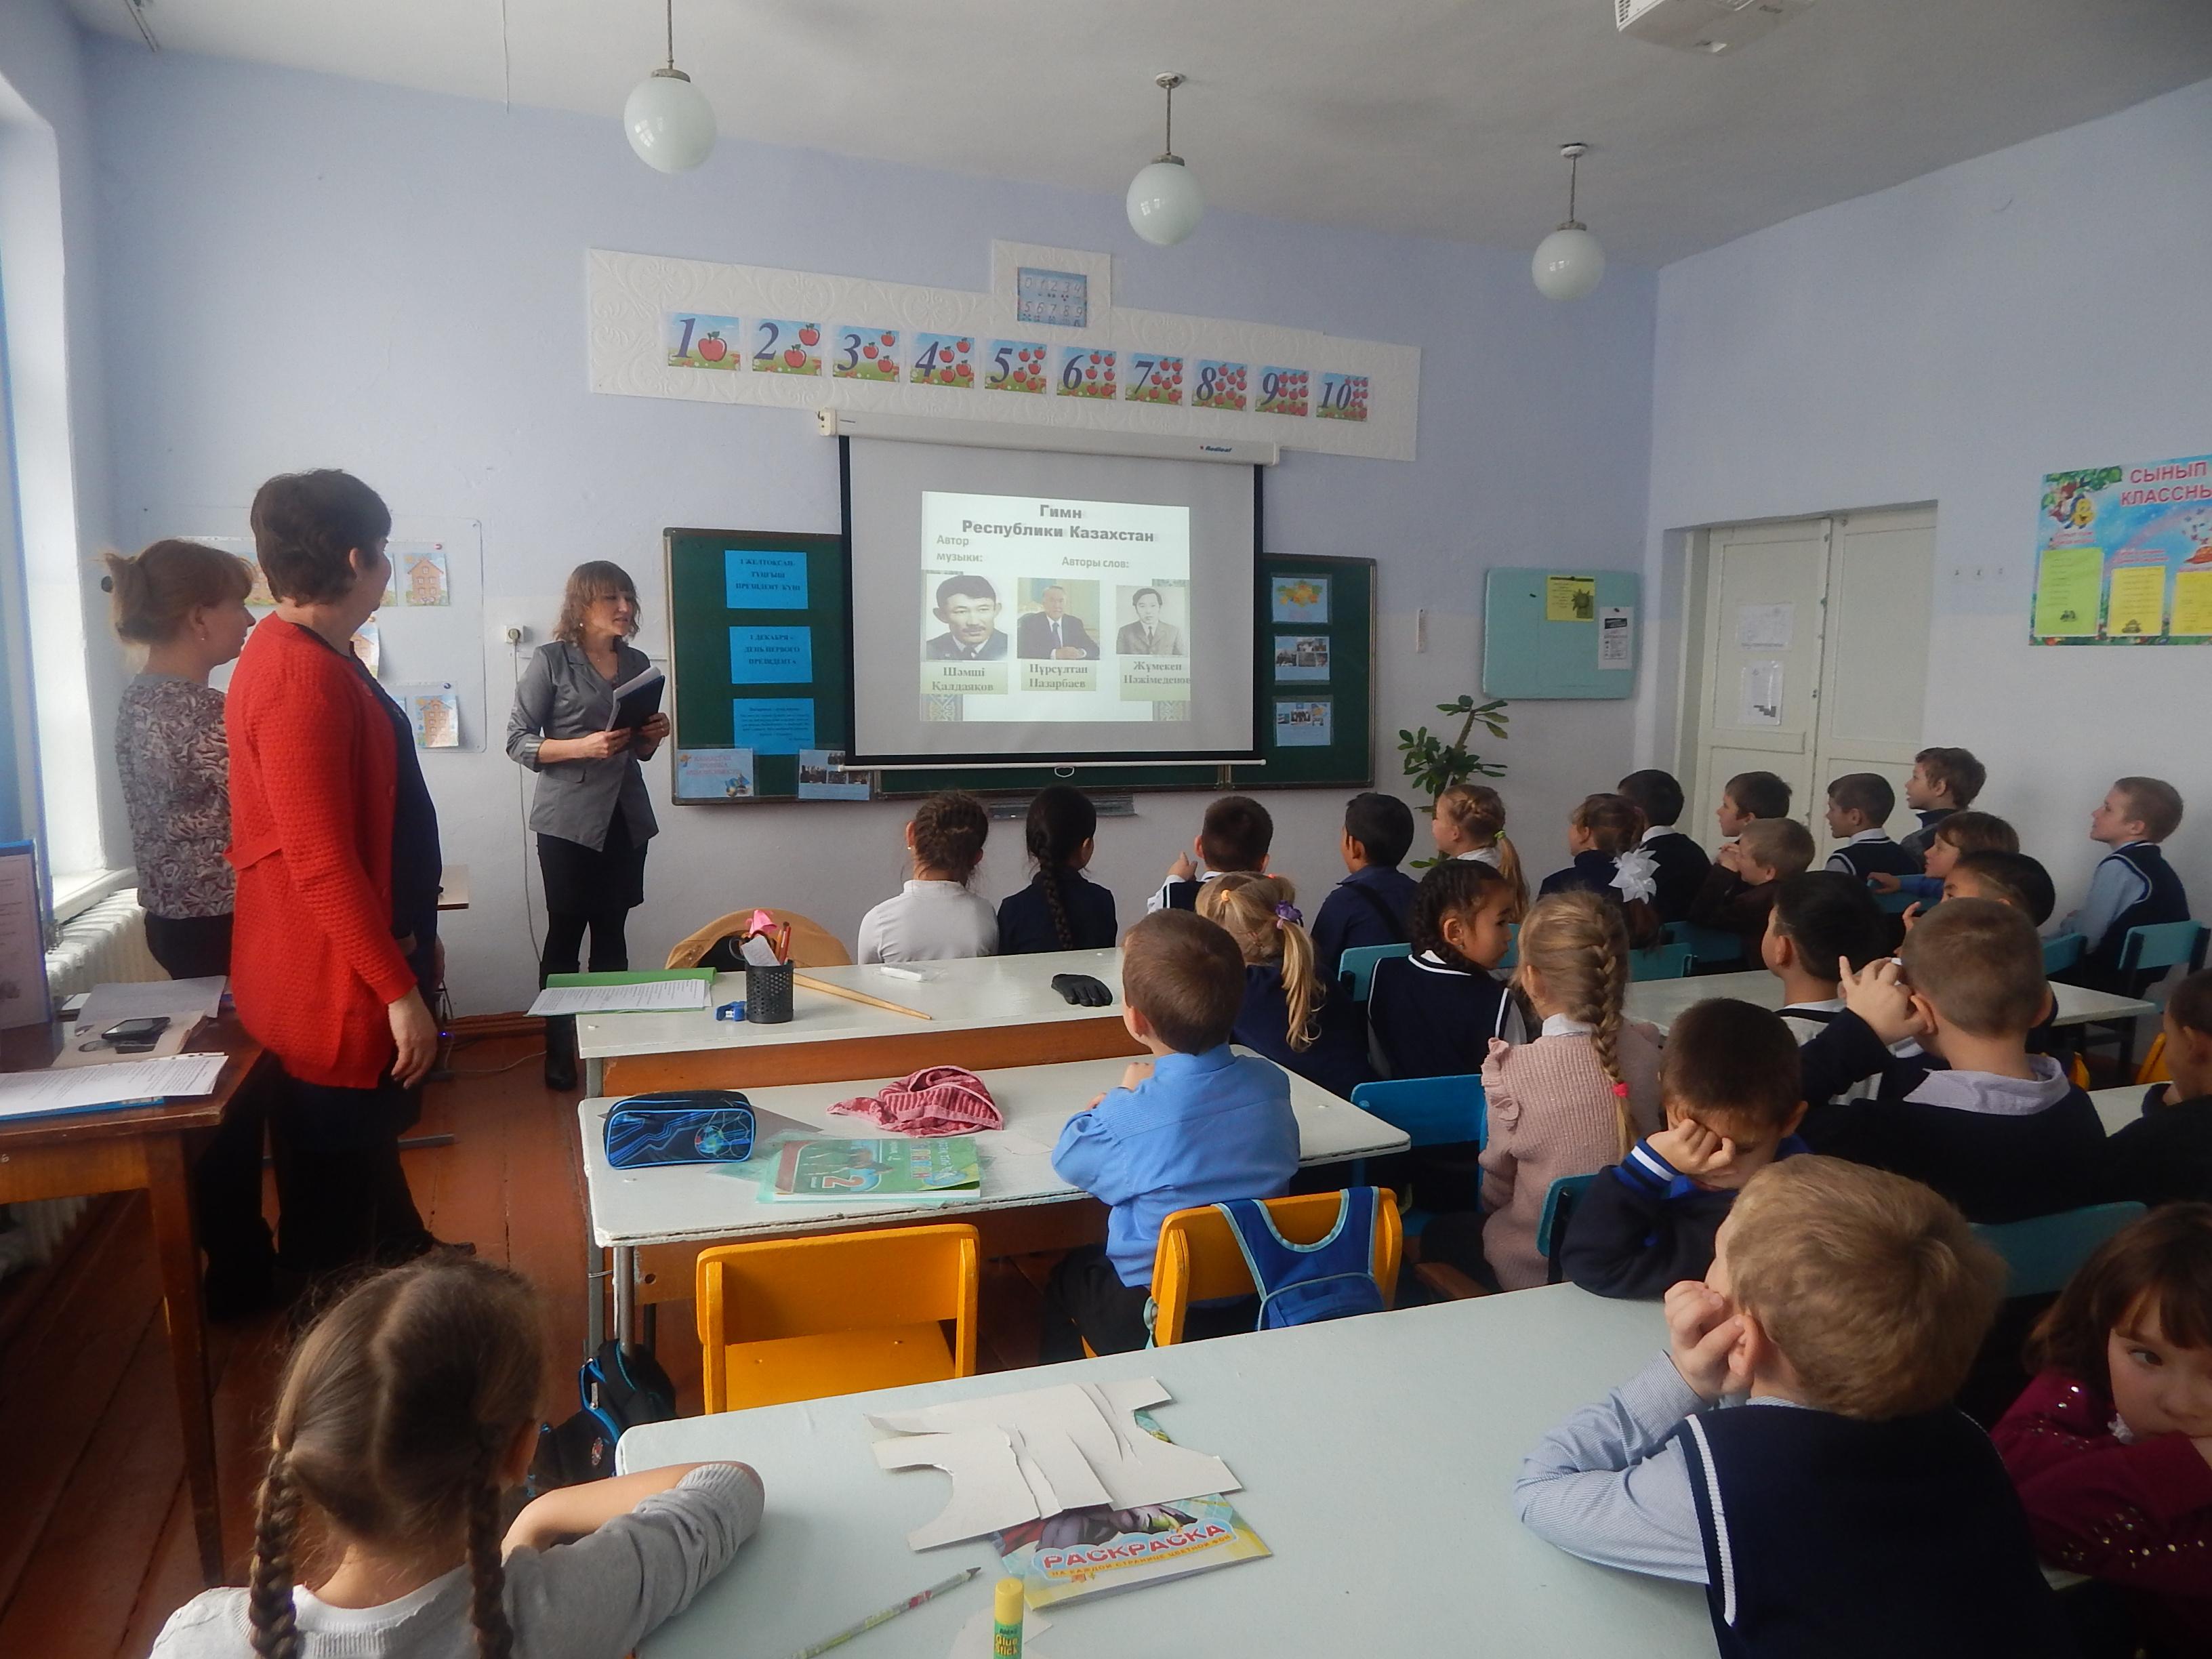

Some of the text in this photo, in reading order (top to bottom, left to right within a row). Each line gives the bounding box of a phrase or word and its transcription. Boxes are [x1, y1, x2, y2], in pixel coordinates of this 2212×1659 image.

[1050, 280, 1057, 291] 2
[1063, 281, 1070, 293] 3
[1024, 301, 1032, 312] 5
[1037, 302, 1044, 314] 6
[1050, 304, 1057, 314] 7
[1063, 305, 1070, 317] 8
[672, 318, 1351, 410] 1 2 3 4 5 6 7 8 9 10
[2130, 462, 2207, 483] СЫНЫП
[1040, 504, 1082, 519] Гимн
[962, 520, 1155, 542] Республики Казахстан
[937, 535, 970, 548] Автор
[937, 552, 983, 563] музыки:
[1062, 556, 1130, 569] Авторы слов:
[943, 667, 985, 676] Шәмші
[1029, 678, 1086, 690] Назарбаев
[822, 1175, 865, 1189] 2
[1043, 1523, 1226, 1569] РАСКРАСКА
